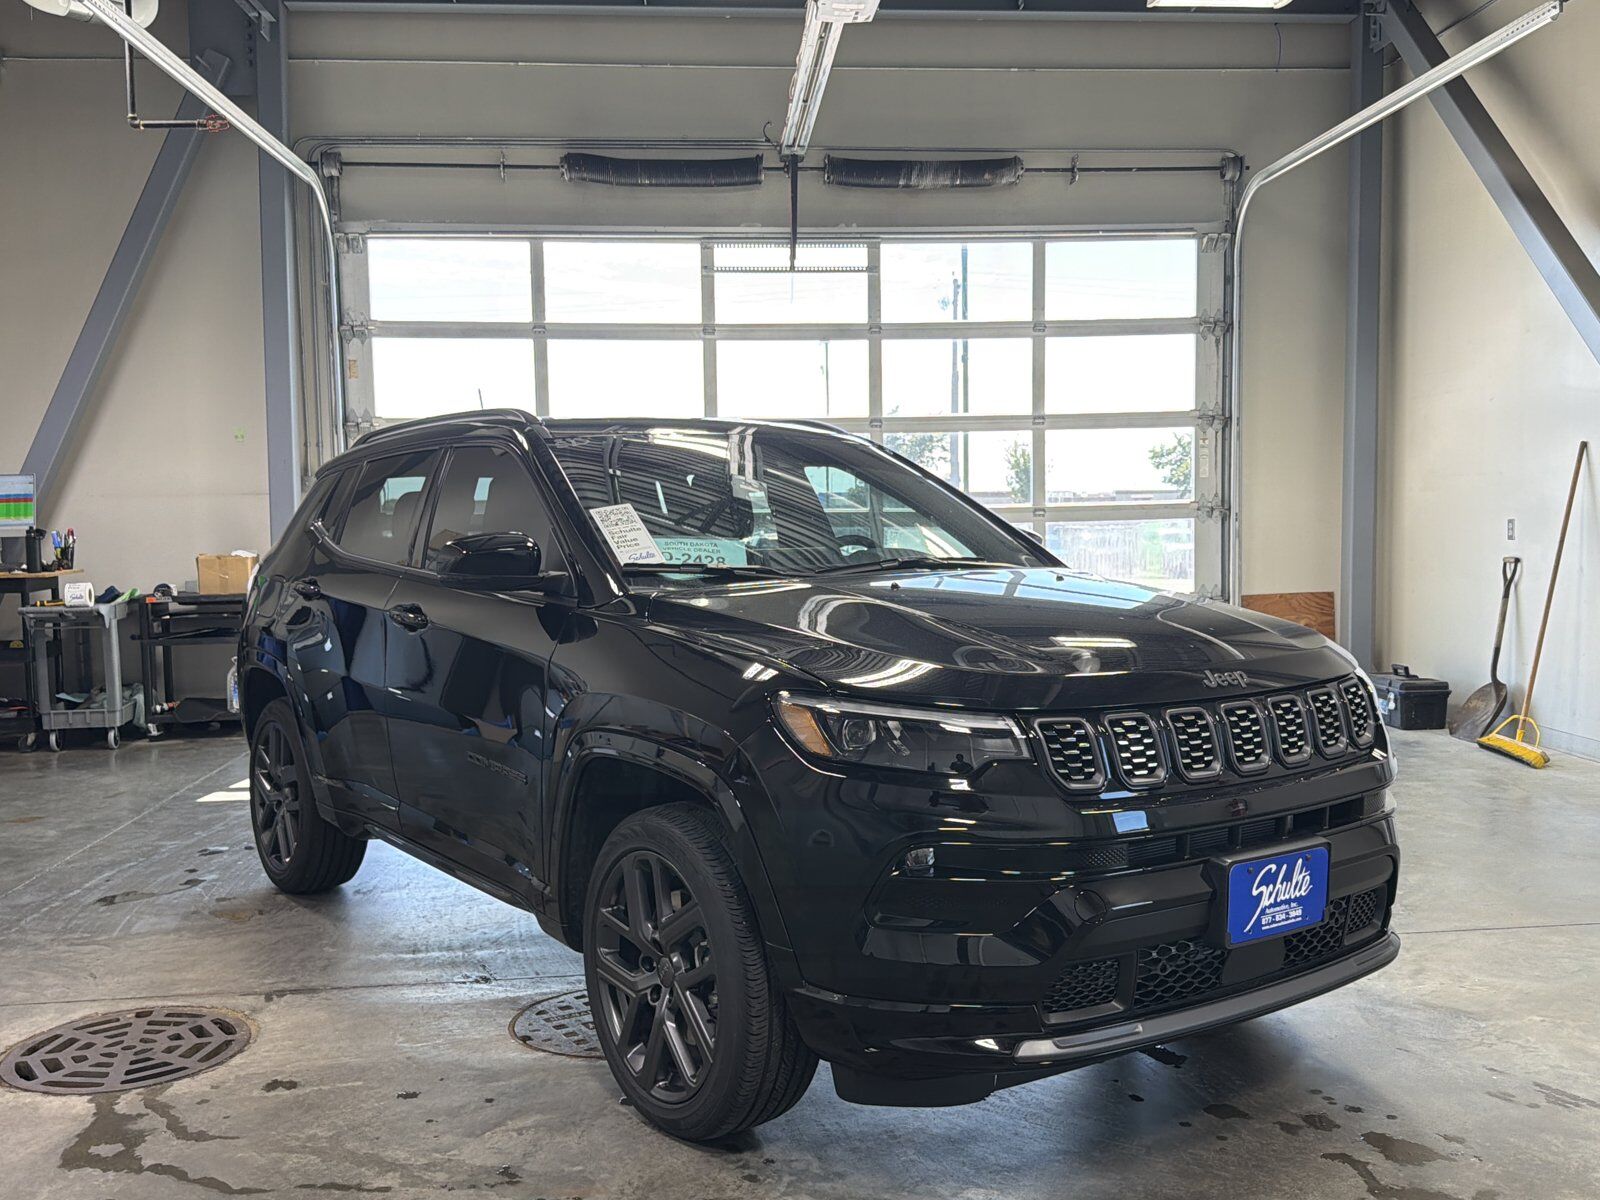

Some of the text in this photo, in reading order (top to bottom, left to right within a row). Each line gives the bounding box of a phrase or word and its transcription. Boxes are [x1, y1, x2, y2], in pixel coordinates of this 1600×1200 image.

[608, 527, 642, 535] Schulte
[613, 537, 639, 545] Value
[1203, 669, 1249, 688] Jeep
[1244, 858, 1313, 933] Schulte
